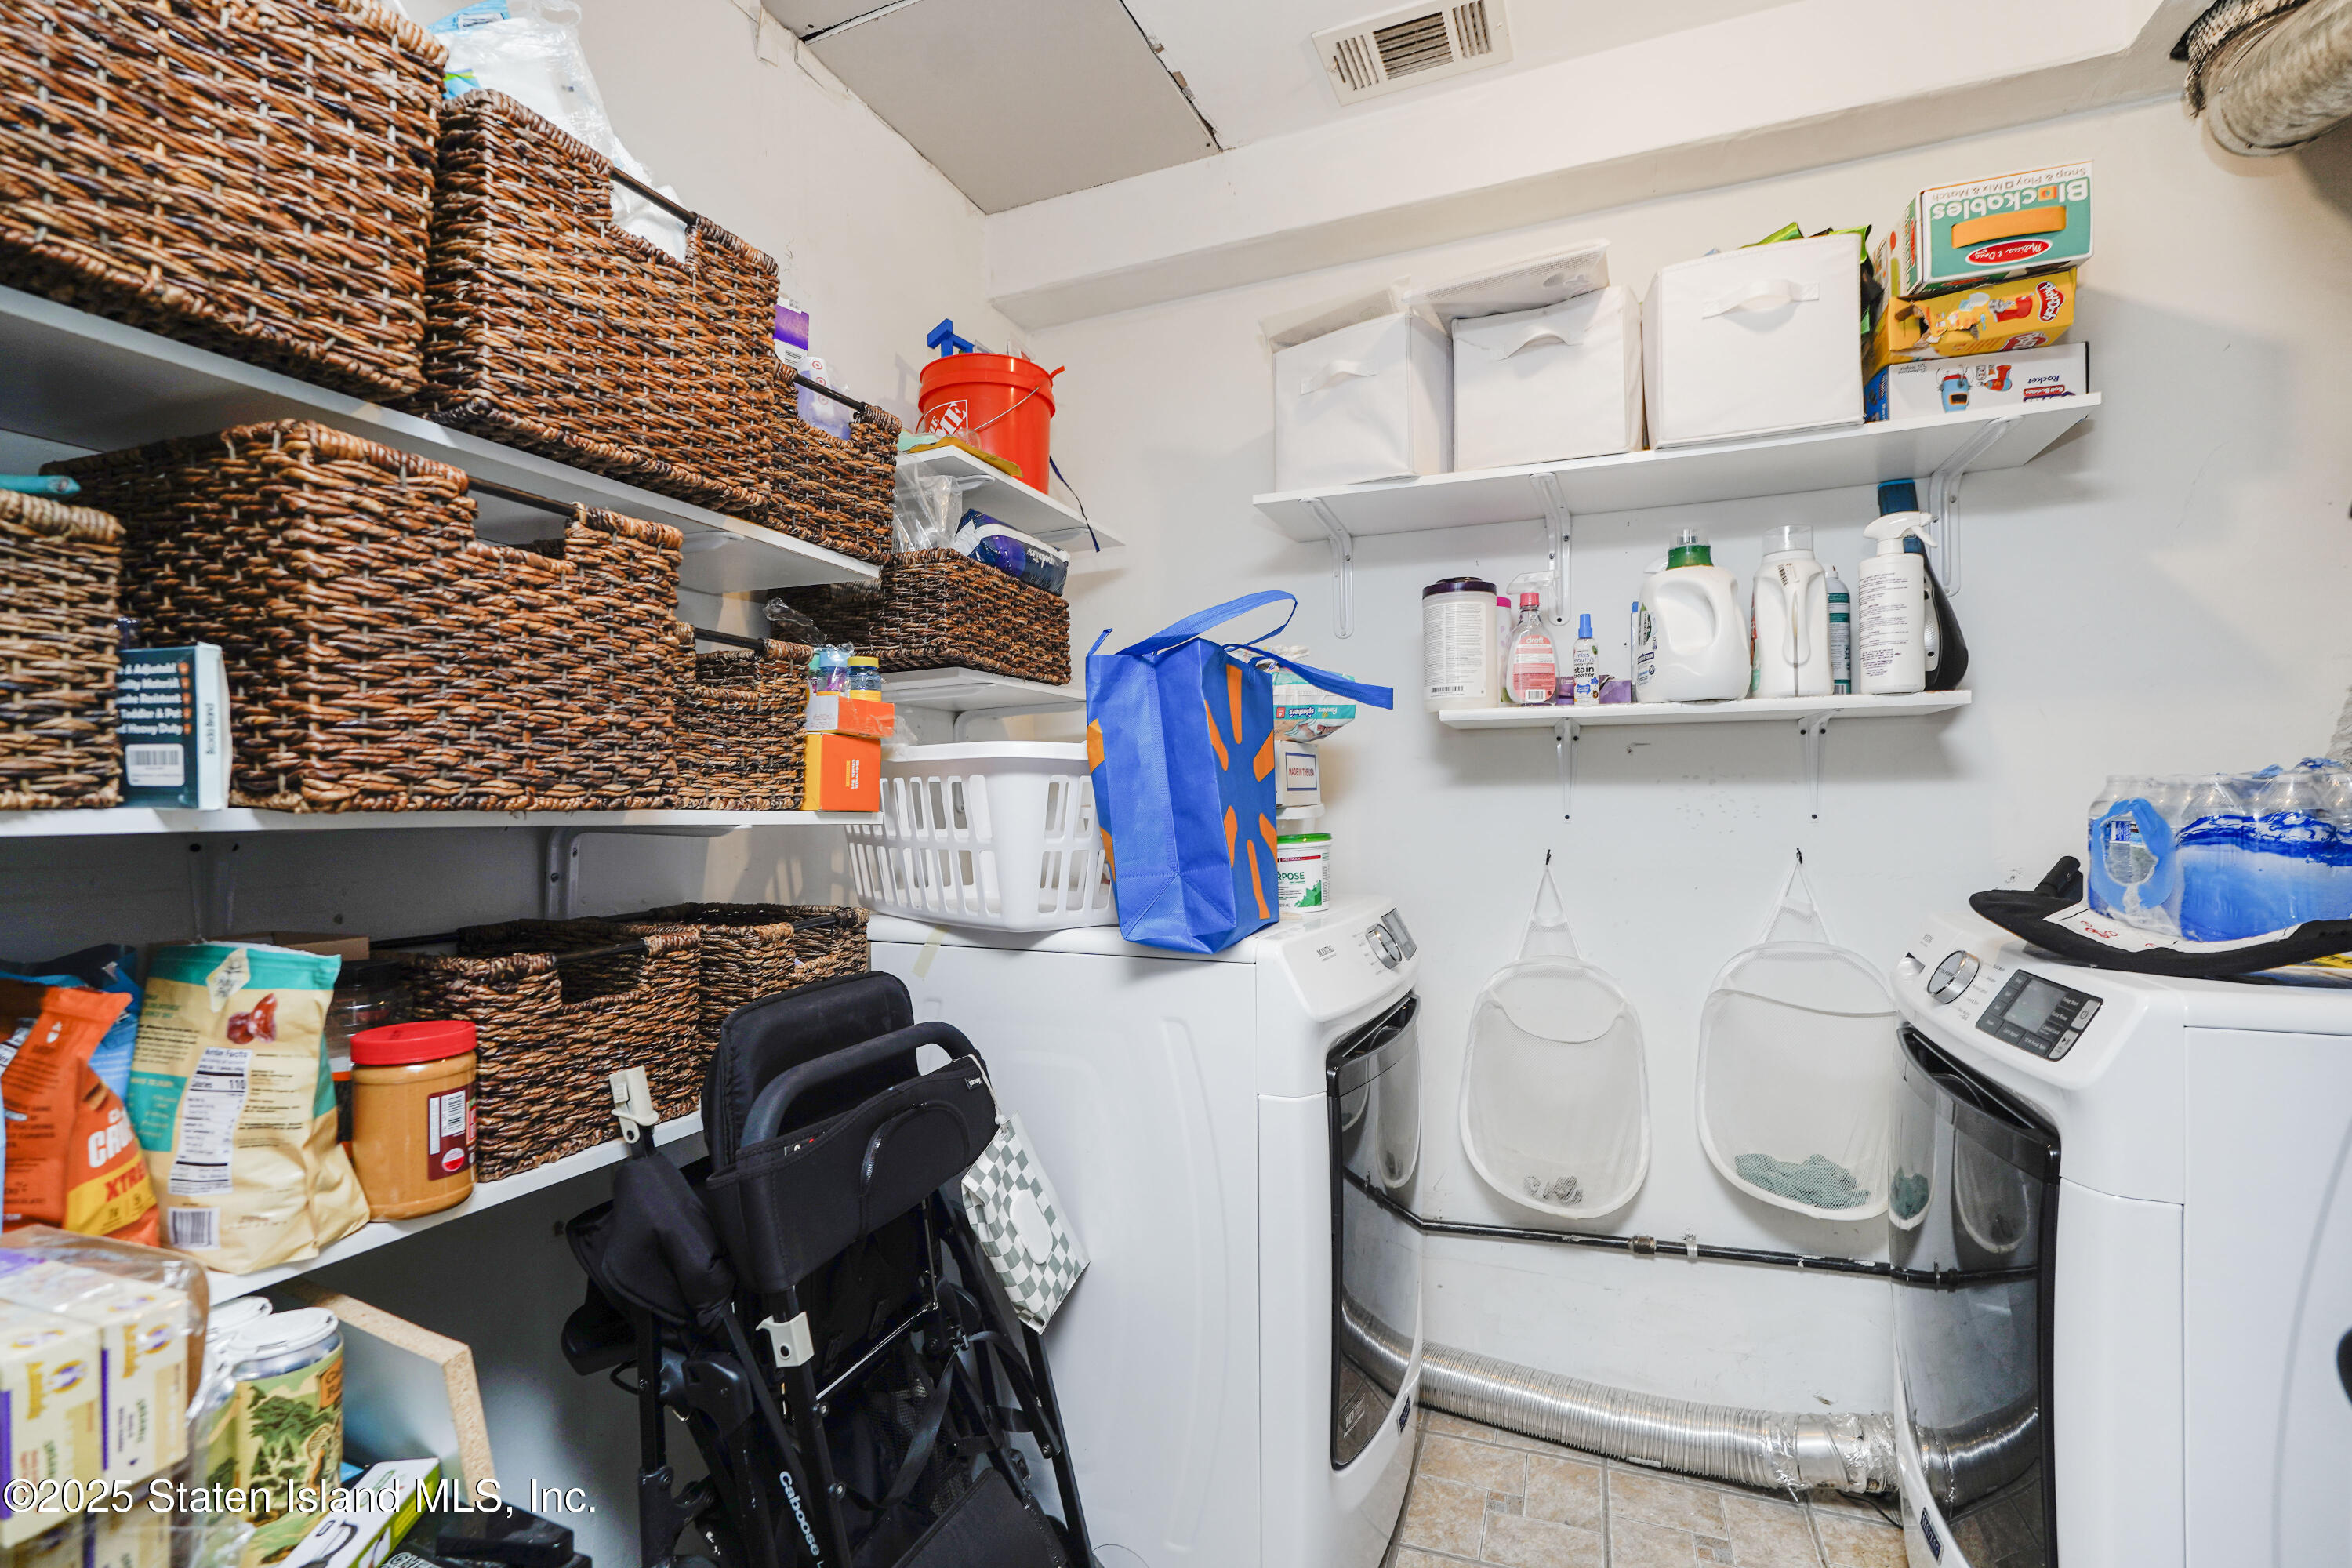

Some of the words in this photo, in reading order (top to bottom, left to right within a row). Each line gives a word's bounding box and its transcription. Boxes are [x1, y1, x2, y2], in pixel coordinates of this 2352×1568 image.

[1982, 182, 2004, 193] Mix
[2015, 176, 2042, 190] Play
[2027, 374, 2060, 384] Rocket
[1288, 768, 1298, 776] MADE
[1277, 871, 1305, 880] RPOSE
[779, 1471, 820, 1556] Caboose
